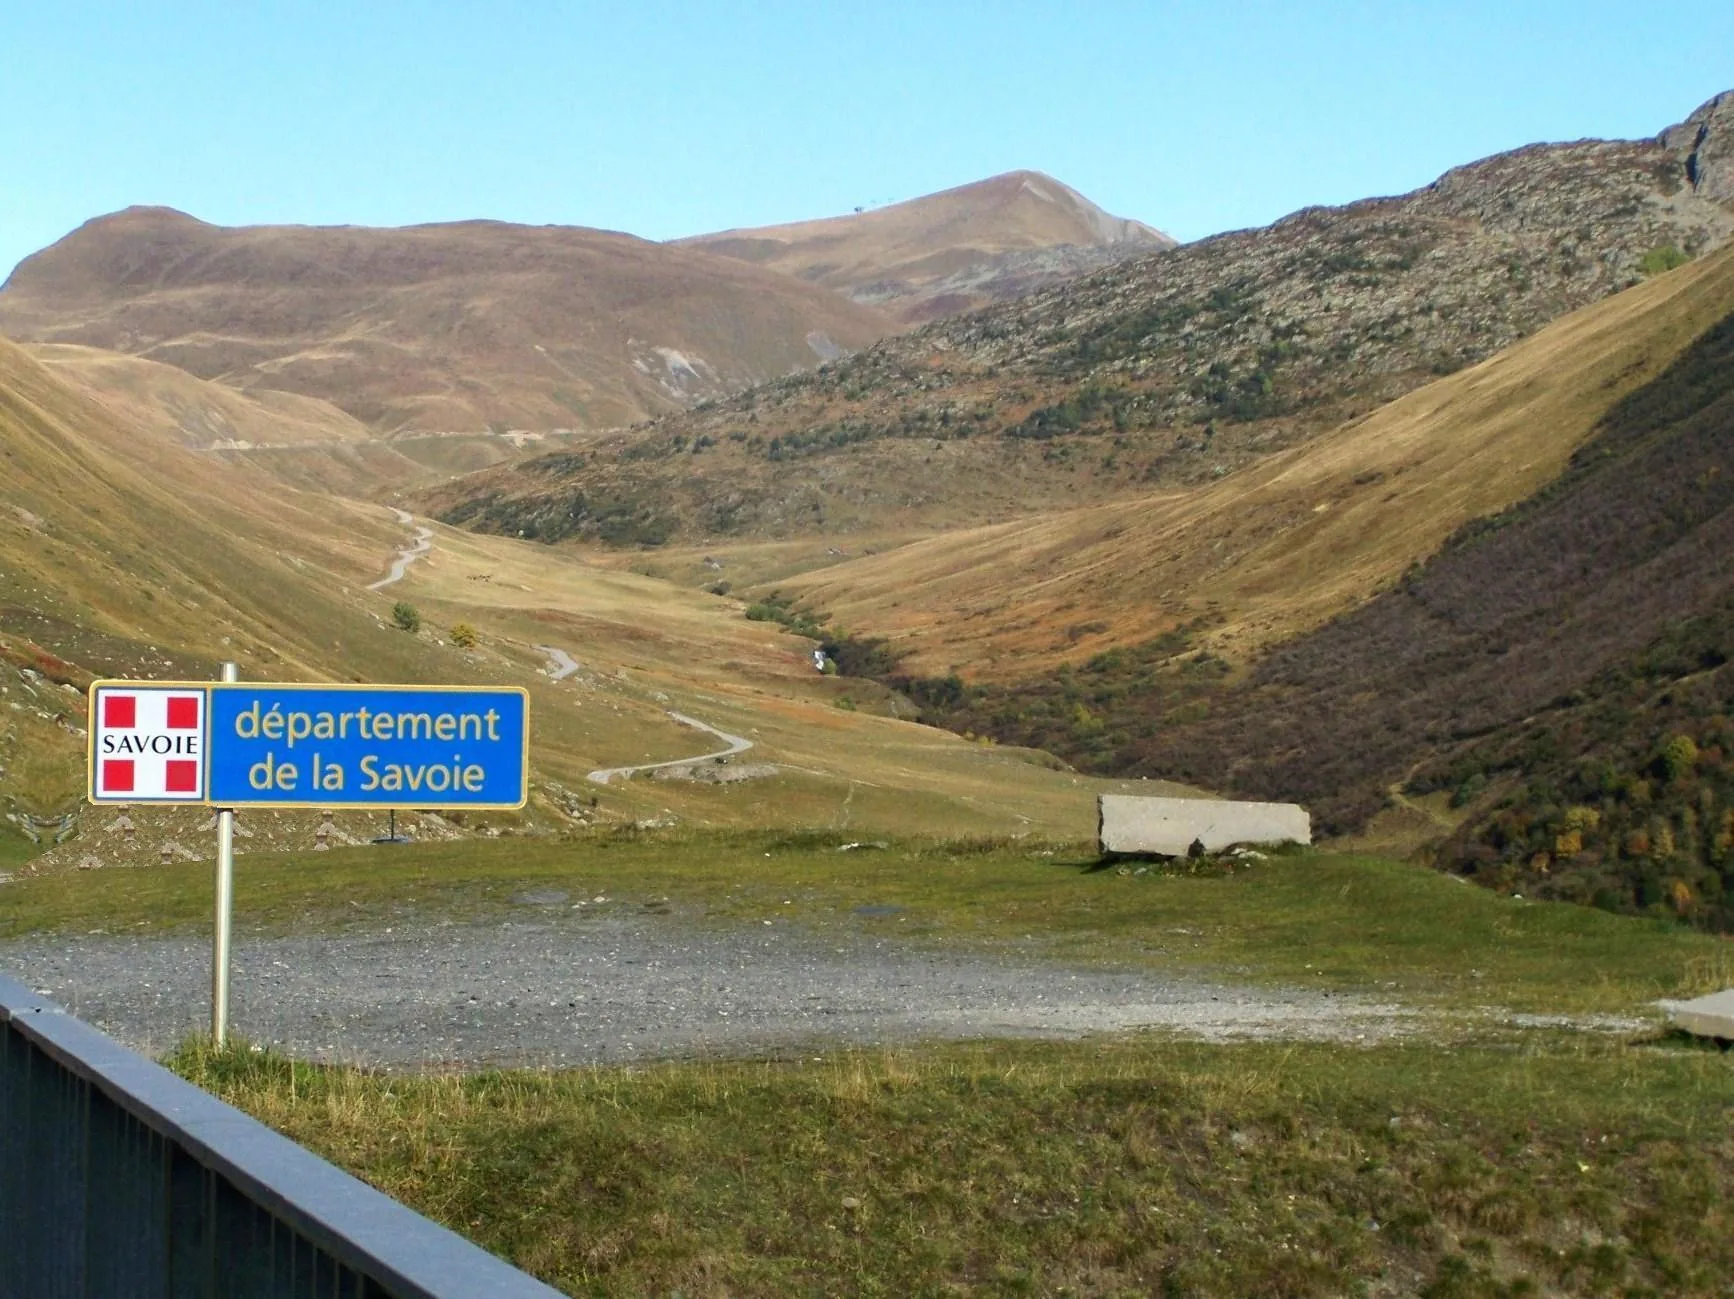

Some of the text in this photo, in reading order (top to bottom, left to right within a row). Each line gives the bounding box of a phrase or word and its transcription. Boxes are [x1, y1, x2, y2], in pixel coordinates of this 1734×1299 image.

[235, 700, 500, 747] département
[103, 734, 198, 754] SAVOIE
[248, 752, 485, 791] de la Savoie
